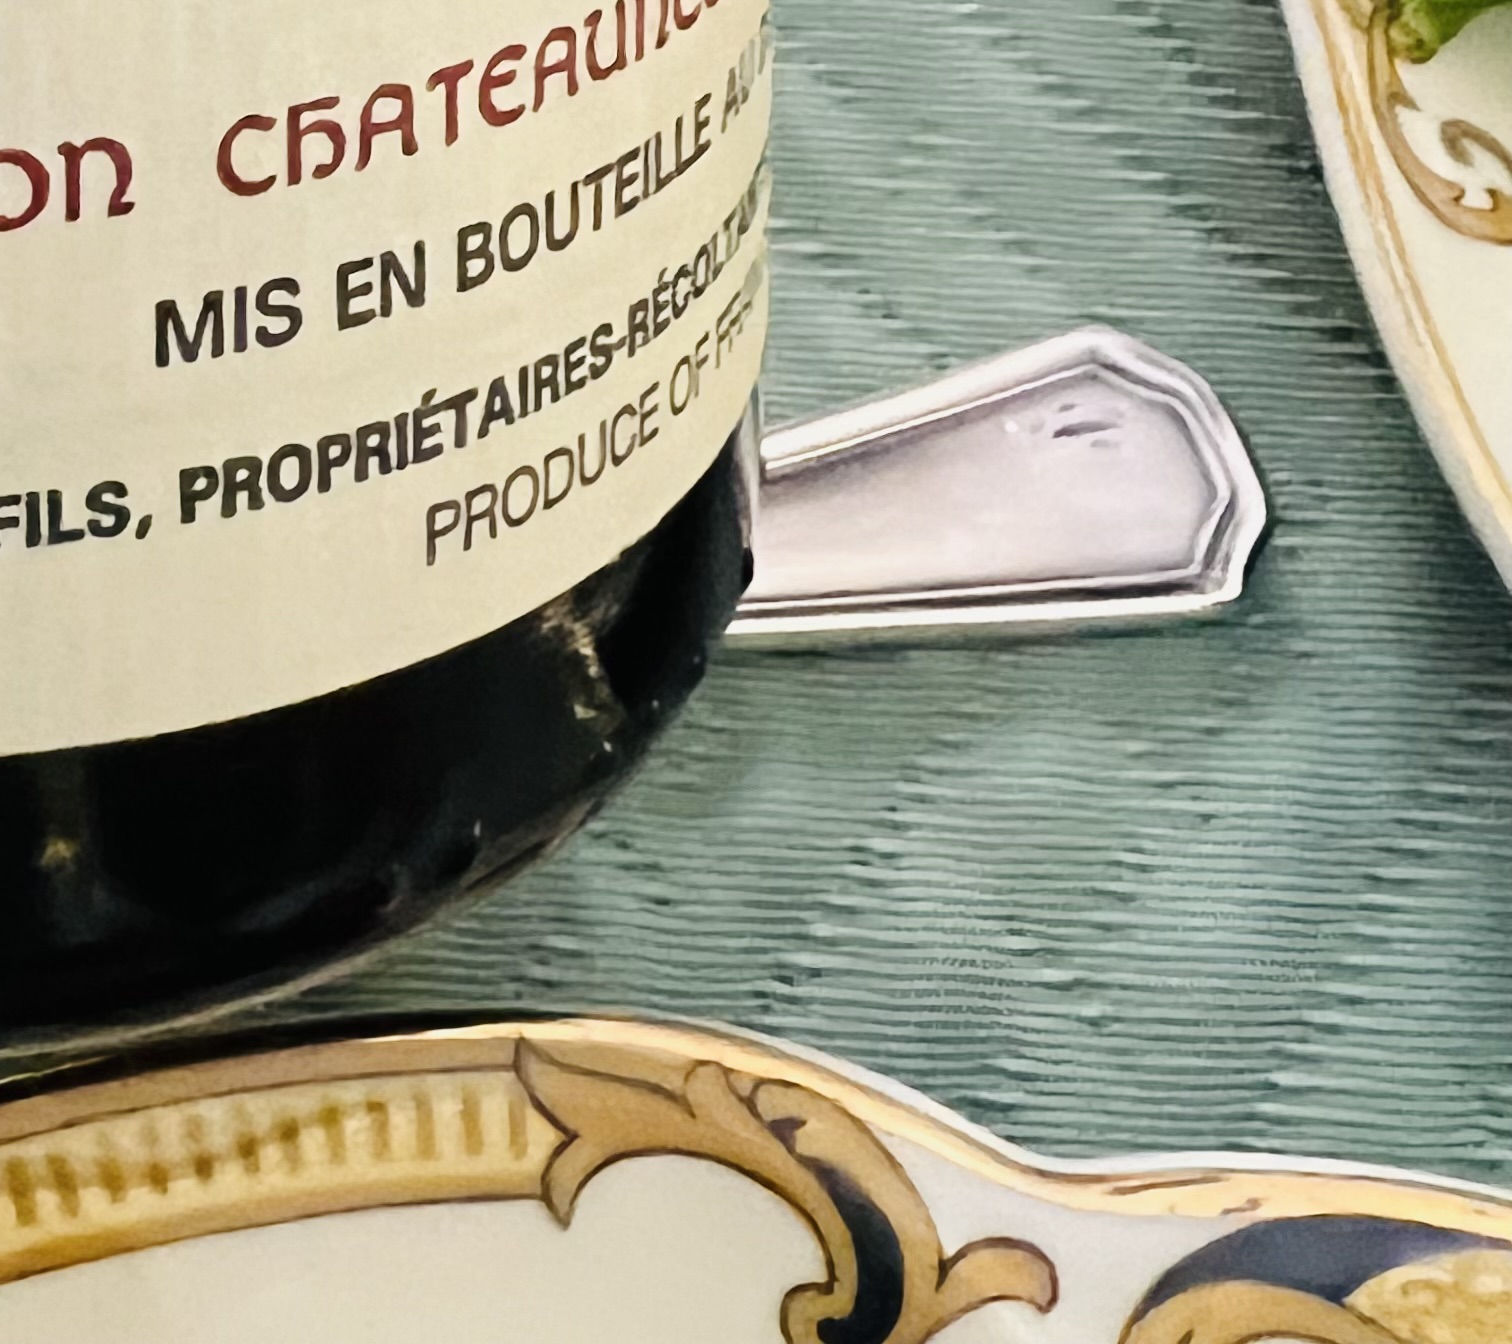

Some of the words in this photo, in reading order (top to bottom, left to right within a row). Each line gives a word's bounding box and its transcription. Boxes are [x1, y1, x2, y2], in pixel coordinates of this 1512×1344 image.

[154, 275, 303, 369] MIS
[334, 239, 427, 332] EN
[454, 92, 713, 294] BOUTEILLE
[424, 380, 660, 566] PRODUCE
[669, 330, 710, 416] OF
